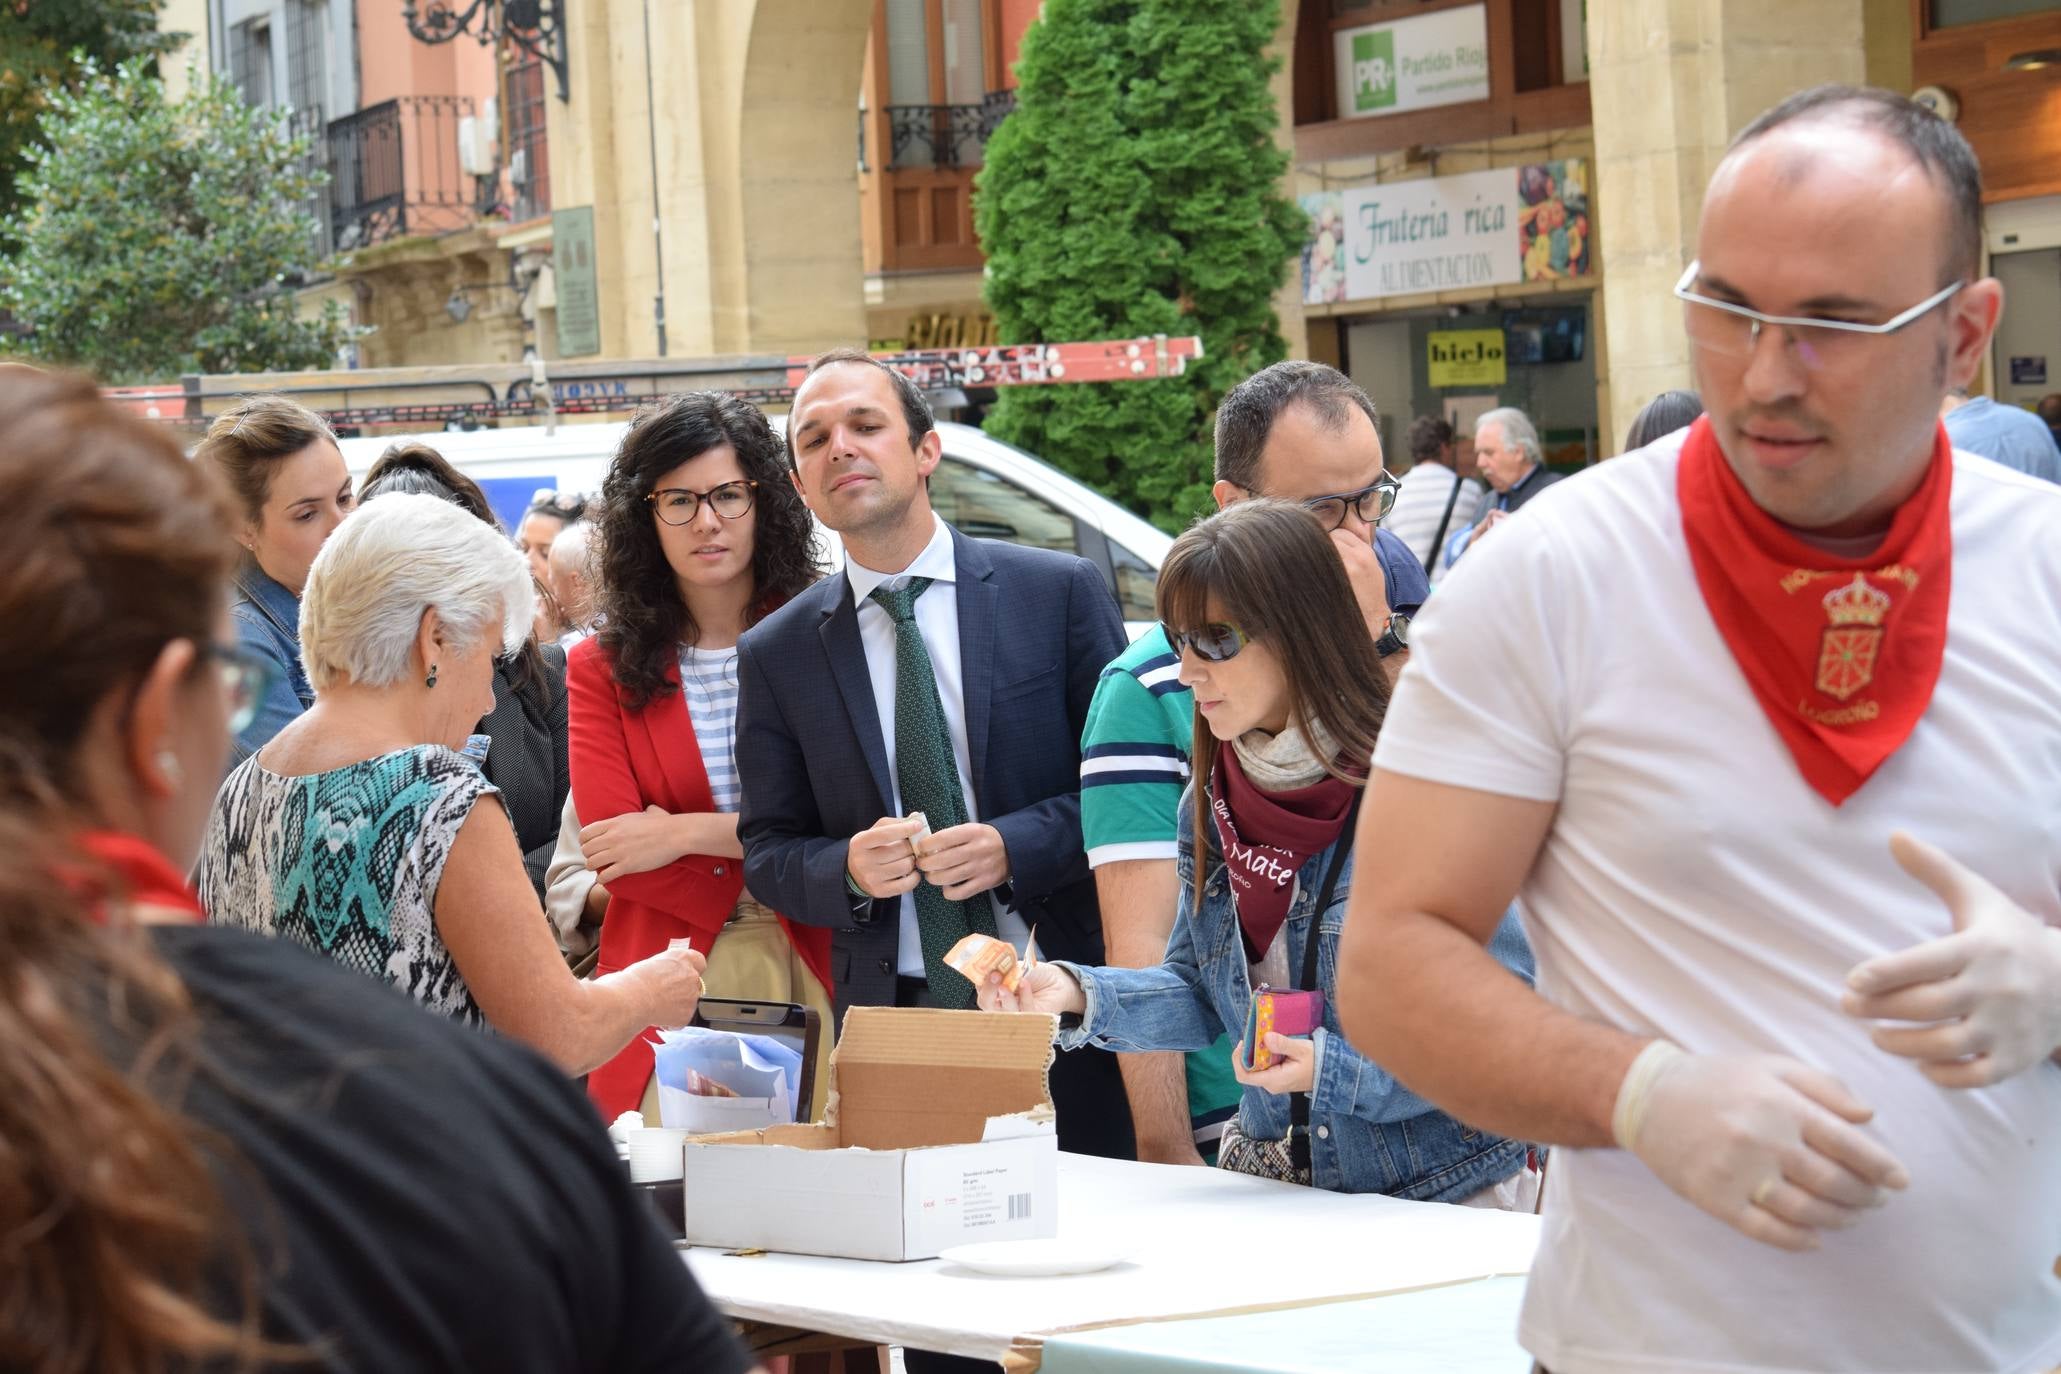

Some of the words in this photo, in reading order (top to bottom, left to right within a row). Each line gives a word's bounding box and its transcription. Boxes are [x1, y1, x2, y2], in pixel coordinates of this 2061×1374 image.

[1401, 49, 1452, 76] Partido
[1455, 44, 1487, 69] Rioj
[1464, 194, 1505, 235] rica
[1380, 253, 1493, 291] ALIMENTACION
